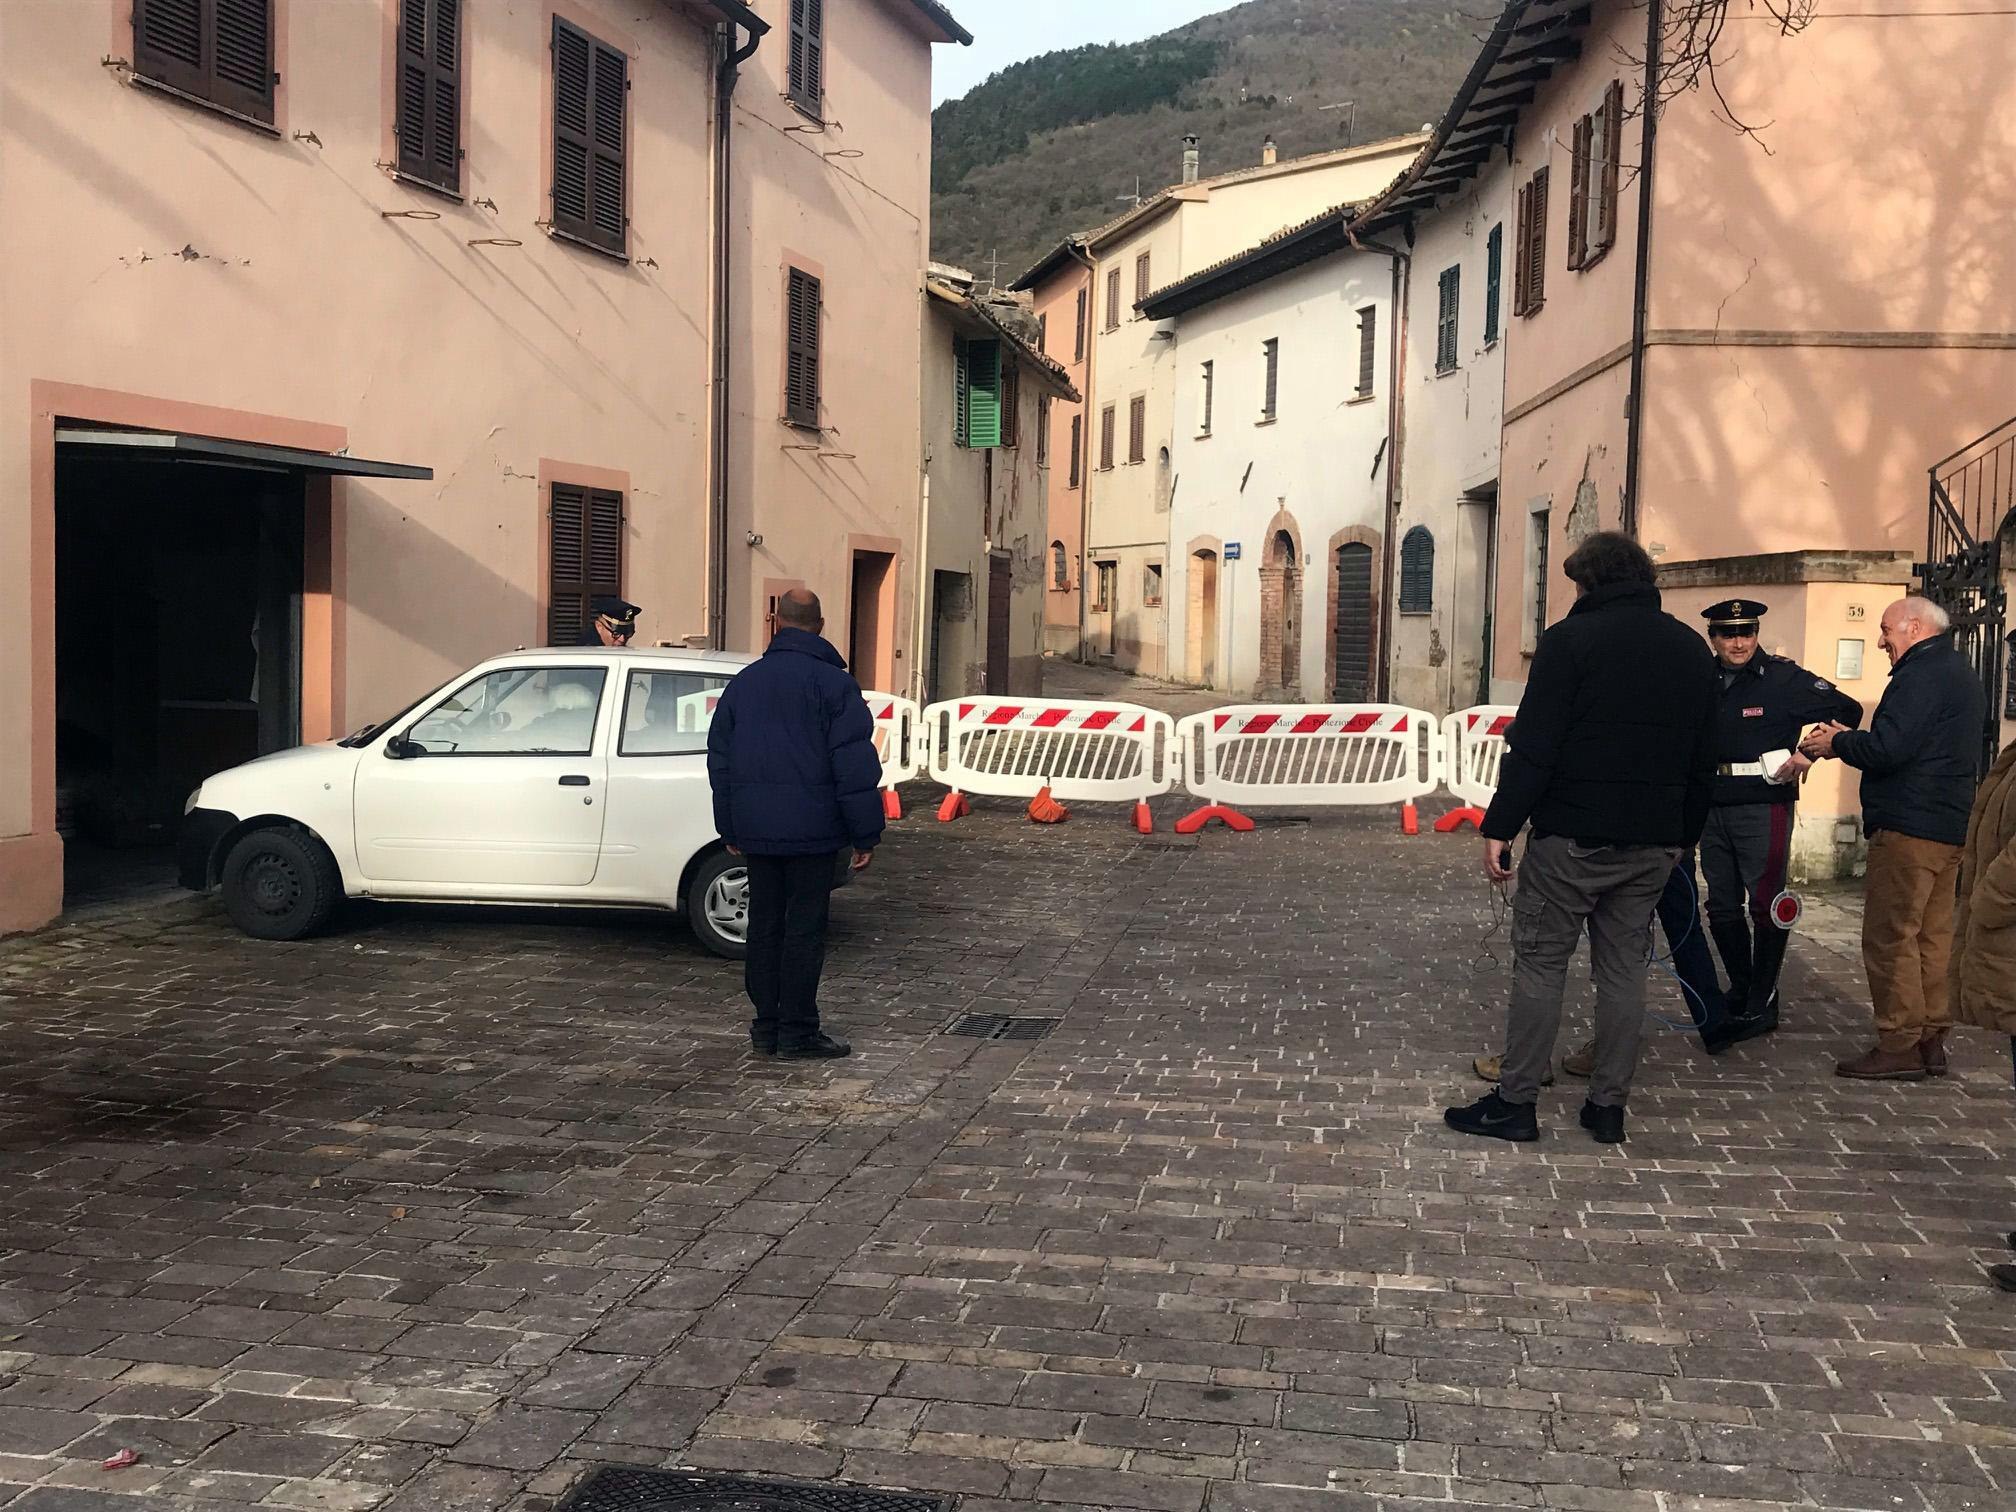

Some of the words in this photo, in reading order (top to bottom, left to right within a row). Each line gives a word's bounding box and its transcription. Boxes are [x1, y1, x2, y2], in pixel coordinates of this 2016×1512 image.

[1848, 606, 1864, 617] 59
[1238, 719, 1271, 729] Regione
[1275, 719, 1303, 727] Marche
[1312, 718, 1356, 727] Protezione
[1359, 717, 1384, 726] Civile
